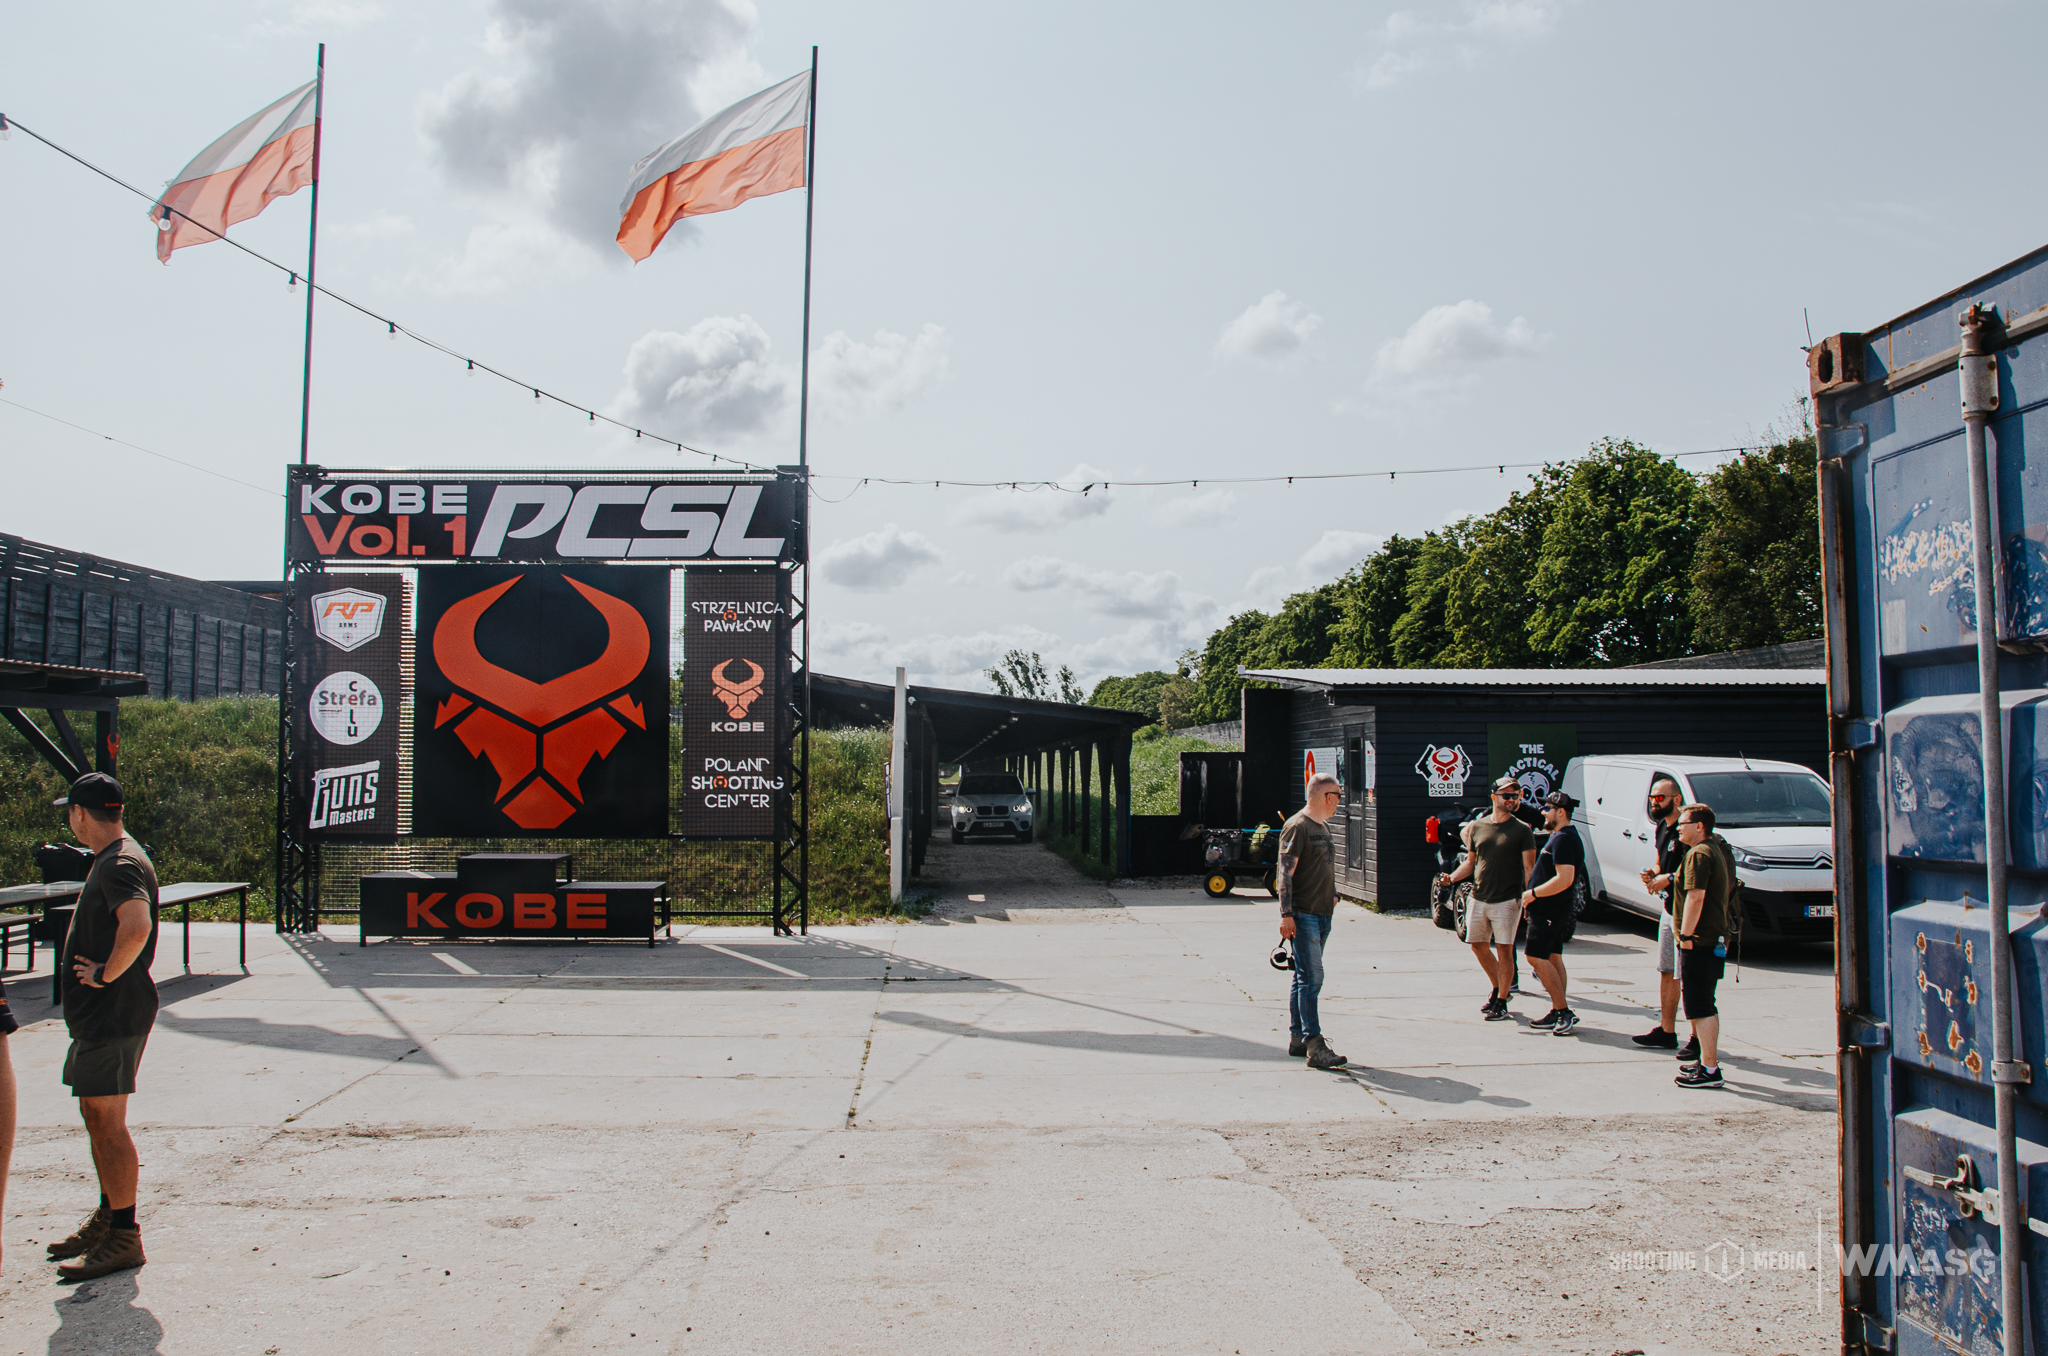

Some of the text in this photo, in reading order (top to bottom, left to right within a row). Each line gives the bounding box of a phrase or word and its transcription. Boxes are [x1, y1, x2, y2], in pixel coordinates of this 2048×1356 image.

[301, 484, 467, 514] KOBE
[471, 485, 785, 557] PCSL
[302, 515, 467, 556] Vol. 1
[322, 602, 376, 619] RP
[691, 601, 784, 614] STRZELNICA
[704, 616, 772, 632] PAWŁÓW
[318, 690, 377, 706] Strefa
[711, 721, 765, 732] KOBE
[1518, 744, 1545, 754] THE
[704, 758, 770, 772] POLAND
[691, 775, 784, 790] SHOOTING
[704, 794, 770, 808] CENTER
[329, 807, 375, 826] Masters
[406, 893, 607, 929] KOBE
